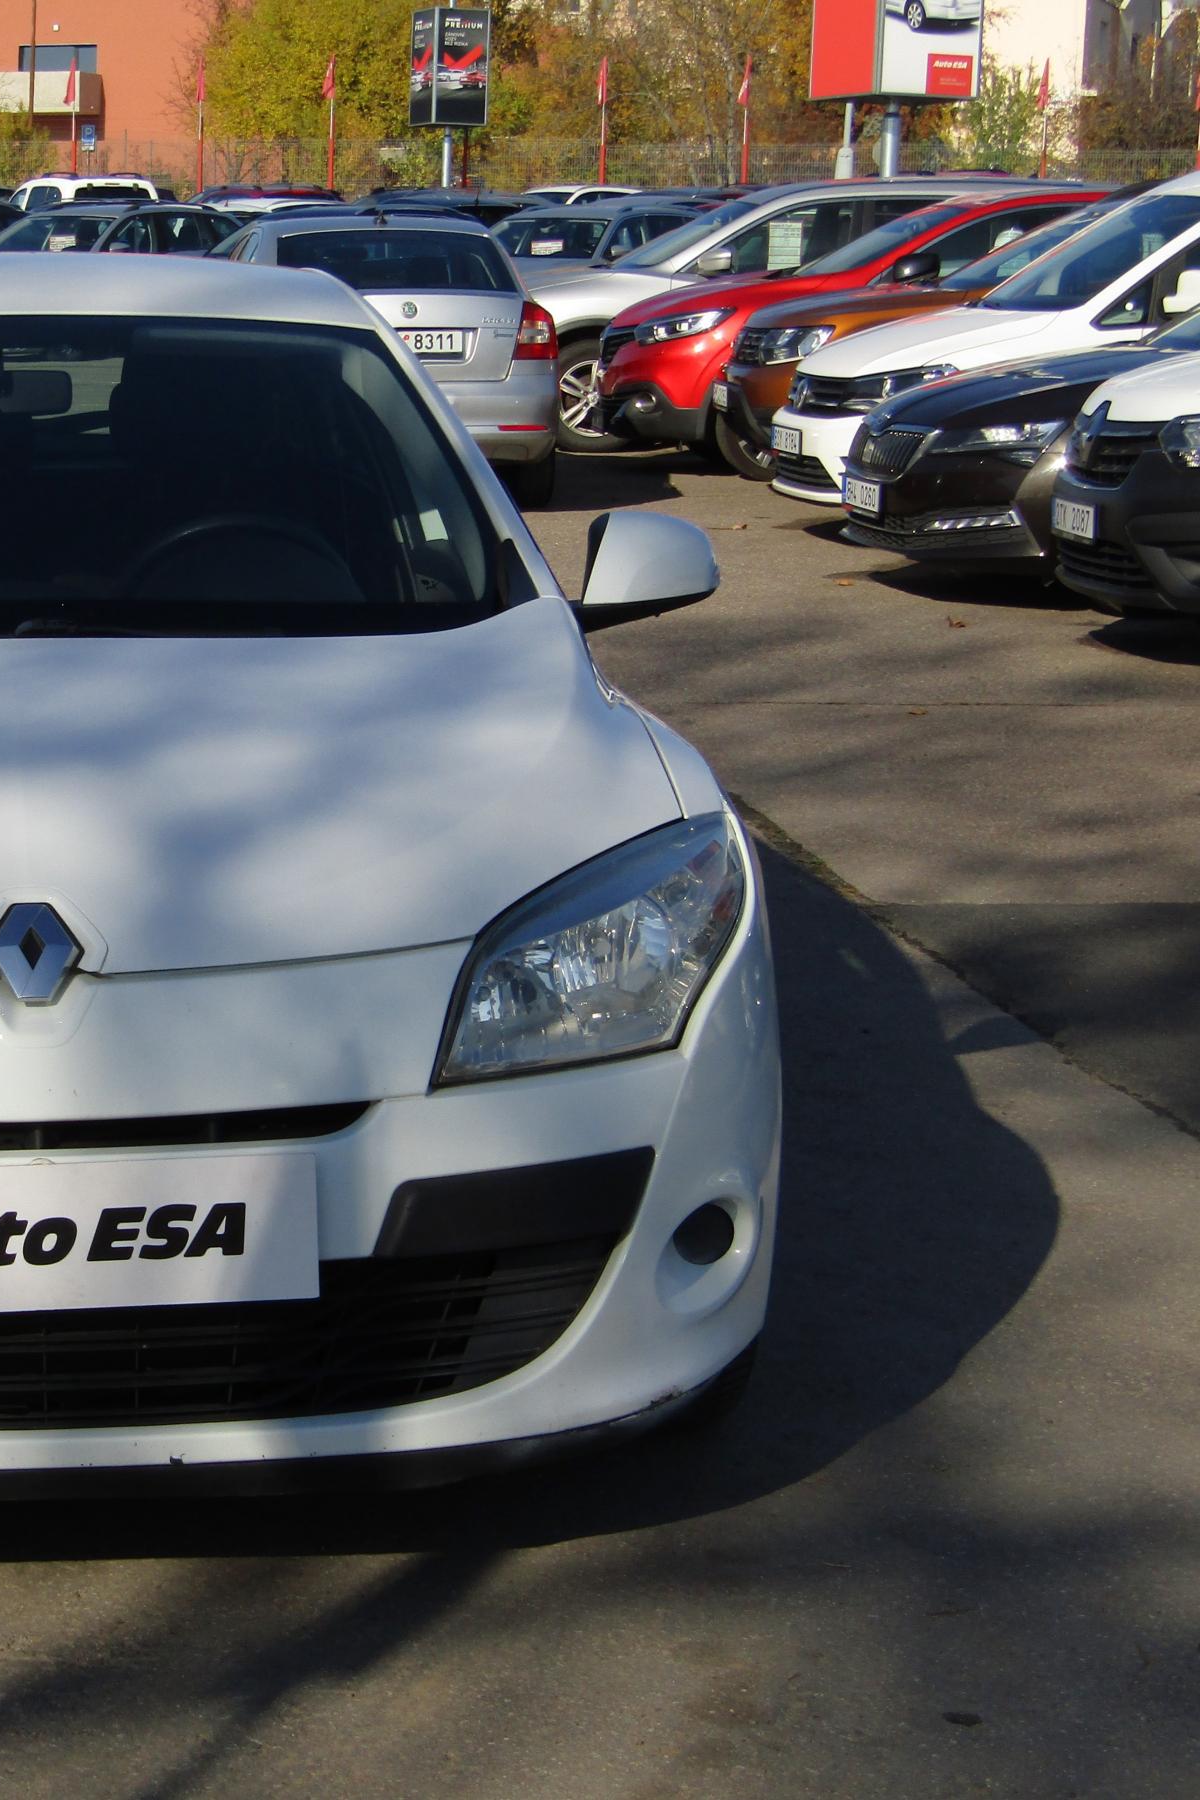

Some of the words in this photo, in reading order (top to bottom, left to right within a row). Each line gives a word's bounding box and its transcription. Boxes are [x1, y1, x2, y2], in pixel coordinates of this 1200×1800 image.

[445, 22, 483, 30] PREMIUM
[933, 60, 952, 68] Auto
[952, 61, 968, 69] ESA
[414, 333, 454, 351] 8311
[860, 485, 876, 507] 0260
[1072, 507, 1090, 534] 2087
[86, 1202, 246, 1262] ESA
